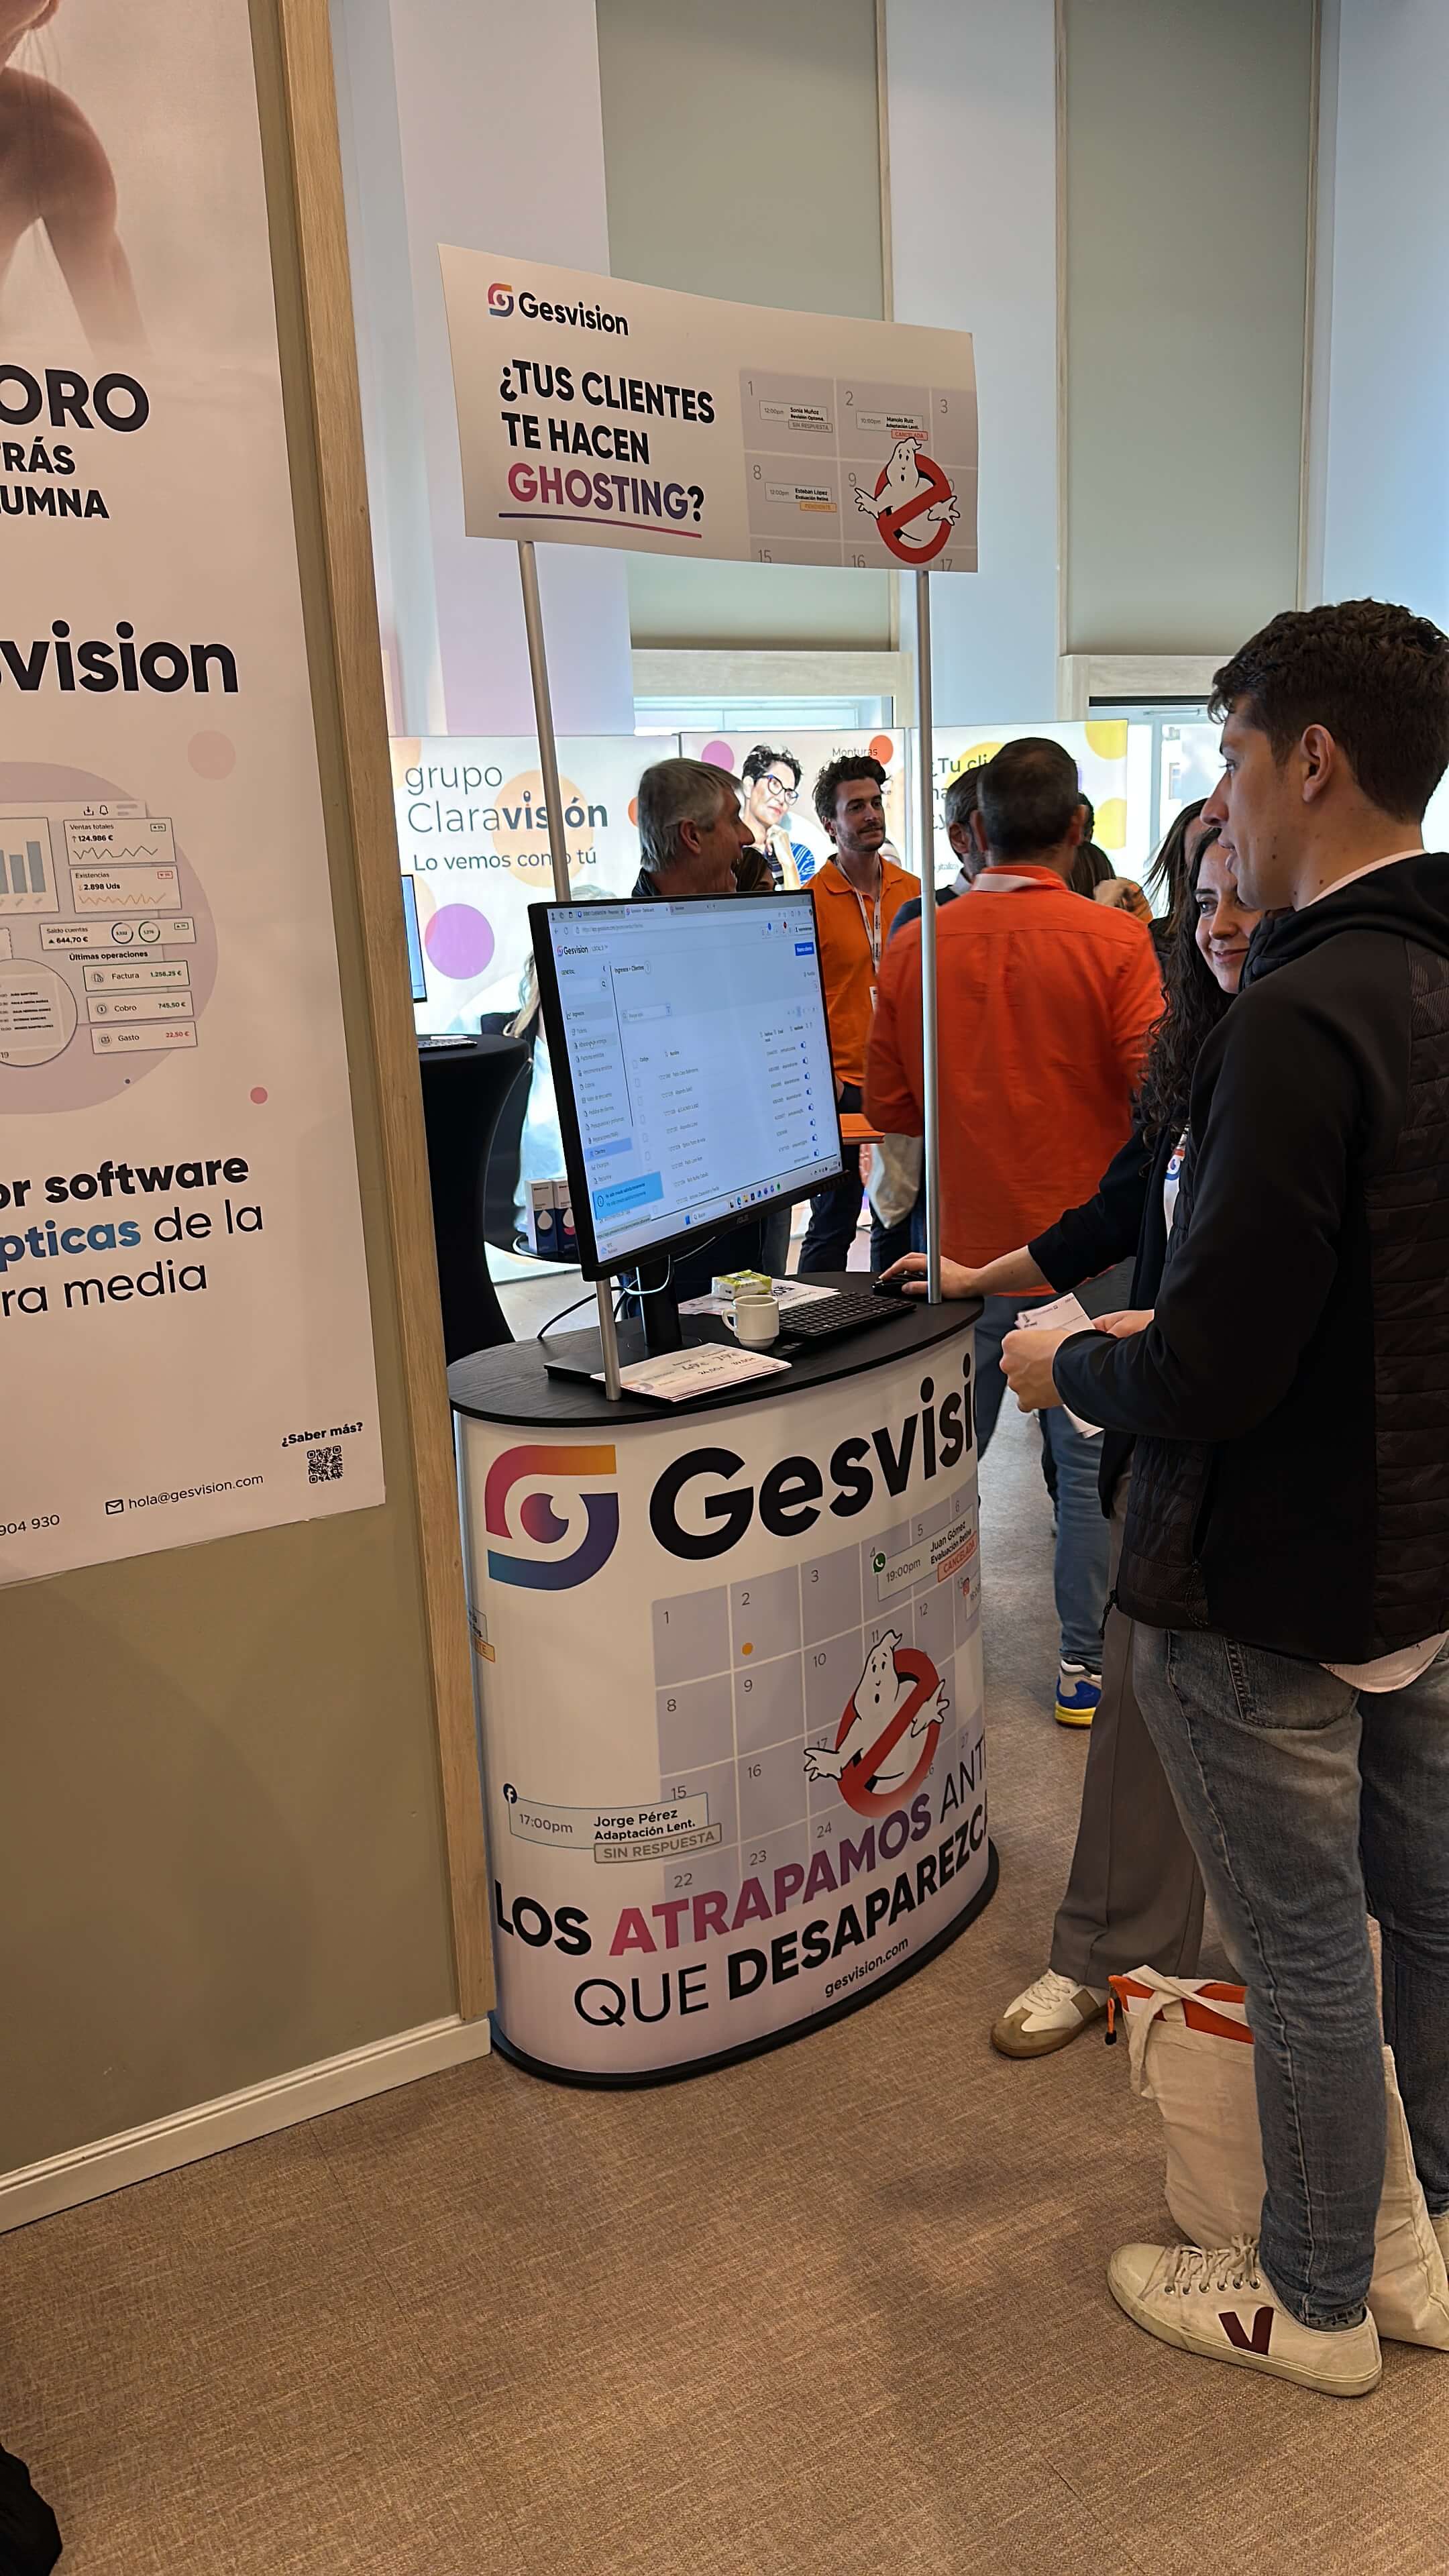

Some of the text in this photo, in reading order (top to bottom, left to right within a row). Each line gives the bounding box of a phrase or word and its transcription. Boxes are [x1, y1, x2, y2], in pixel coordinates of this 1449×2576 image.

[519, 291, 629, 335] Gesvision
[500, 359, 715, 423] ¿TUS CLIENTES
[747, 380, 753, 396] 1
[845, 391, 853, 406] 2
[940, 399, 948, 414] 3
[501, 412, 650, 464] TE HACEN
[0, 436, 75, 475] RÁS
[753, 465, 761, 480] 8
[848, 473, 857, 487] 9
[0, 485, 110, 519] UMNA
[508, 463, 704, 521] GHOSTING?
[758, 549, 771, 563] 15
[851, 555, 865, 568] 16
[941, 559, 953, 572] 17
[0, 619, 239, 693] vision
[832, 747, 878, 757] Monturas
[405, 766, 502, 796] grupo
[408, 790, 608, 833] Claravisón
[414, 854, 437, 871] Lo
[444, 854, 511, 869] vemos
[576, 847, 596, 865] tú
[69, 951, 148, 961] Últimas operaciones
[564, 945, 588, 955] Gesvision
[45, 1157, 249, 1203] software
[154, 1206, 211, 1242] de
[225, 1199, 263, 1234] la
[1, 1259, 207, 1317] ra media
[280, 1421, 364, 1448] ¿Saber más?
[649, 1352, 977, 1560] Gesvisi
[128, 1475, 264, 1509] hola@gesvision.com
[32, 1514, 60, 1530] 930
[917, 1523, 923, 1536] 5
[930, 1521, 966, 1552] Juan Gómez
[930, 1542, 959, 1564] Evaluación
[943, 1540, 975, 1573] CANCELADA
[811, 1570, 818, 1583] 3
[885, 1558, 921, 1583] 19:00pm
[742, 1593, 751, 1607] 2
[919, 1603, 928, 1616] 12
[663, 1611, 669, 1623] 1
[813, 1653, 827, 1668] 10
[744, 1679, 753, 1693] 9
[666, 1699, 676, 1713] 8
[747, 1764, 761, 1779] 16
[671, 1784, 687, 1799] 15
[519, 1813, 574, 1835] 17:00pm
[594, 1807, 678, 1829] Jorge Pérez
[594, 1818, 696, 1841] Adaptación Lent.
[816, 1822, 832, 1838] 24
[494, 1731, 985, 1956] LOS ATRAPAMOS ANT
[603, 1830, 715, 1860] SIN RESPUESTA
[749, 1849, 767, 1866] 23
[674, 1873, 692, 1888] 22
[574, 1790, 987, 2027] QUE DESAPAREZC
[824, 1937, 909, 1998] gesvision.com
